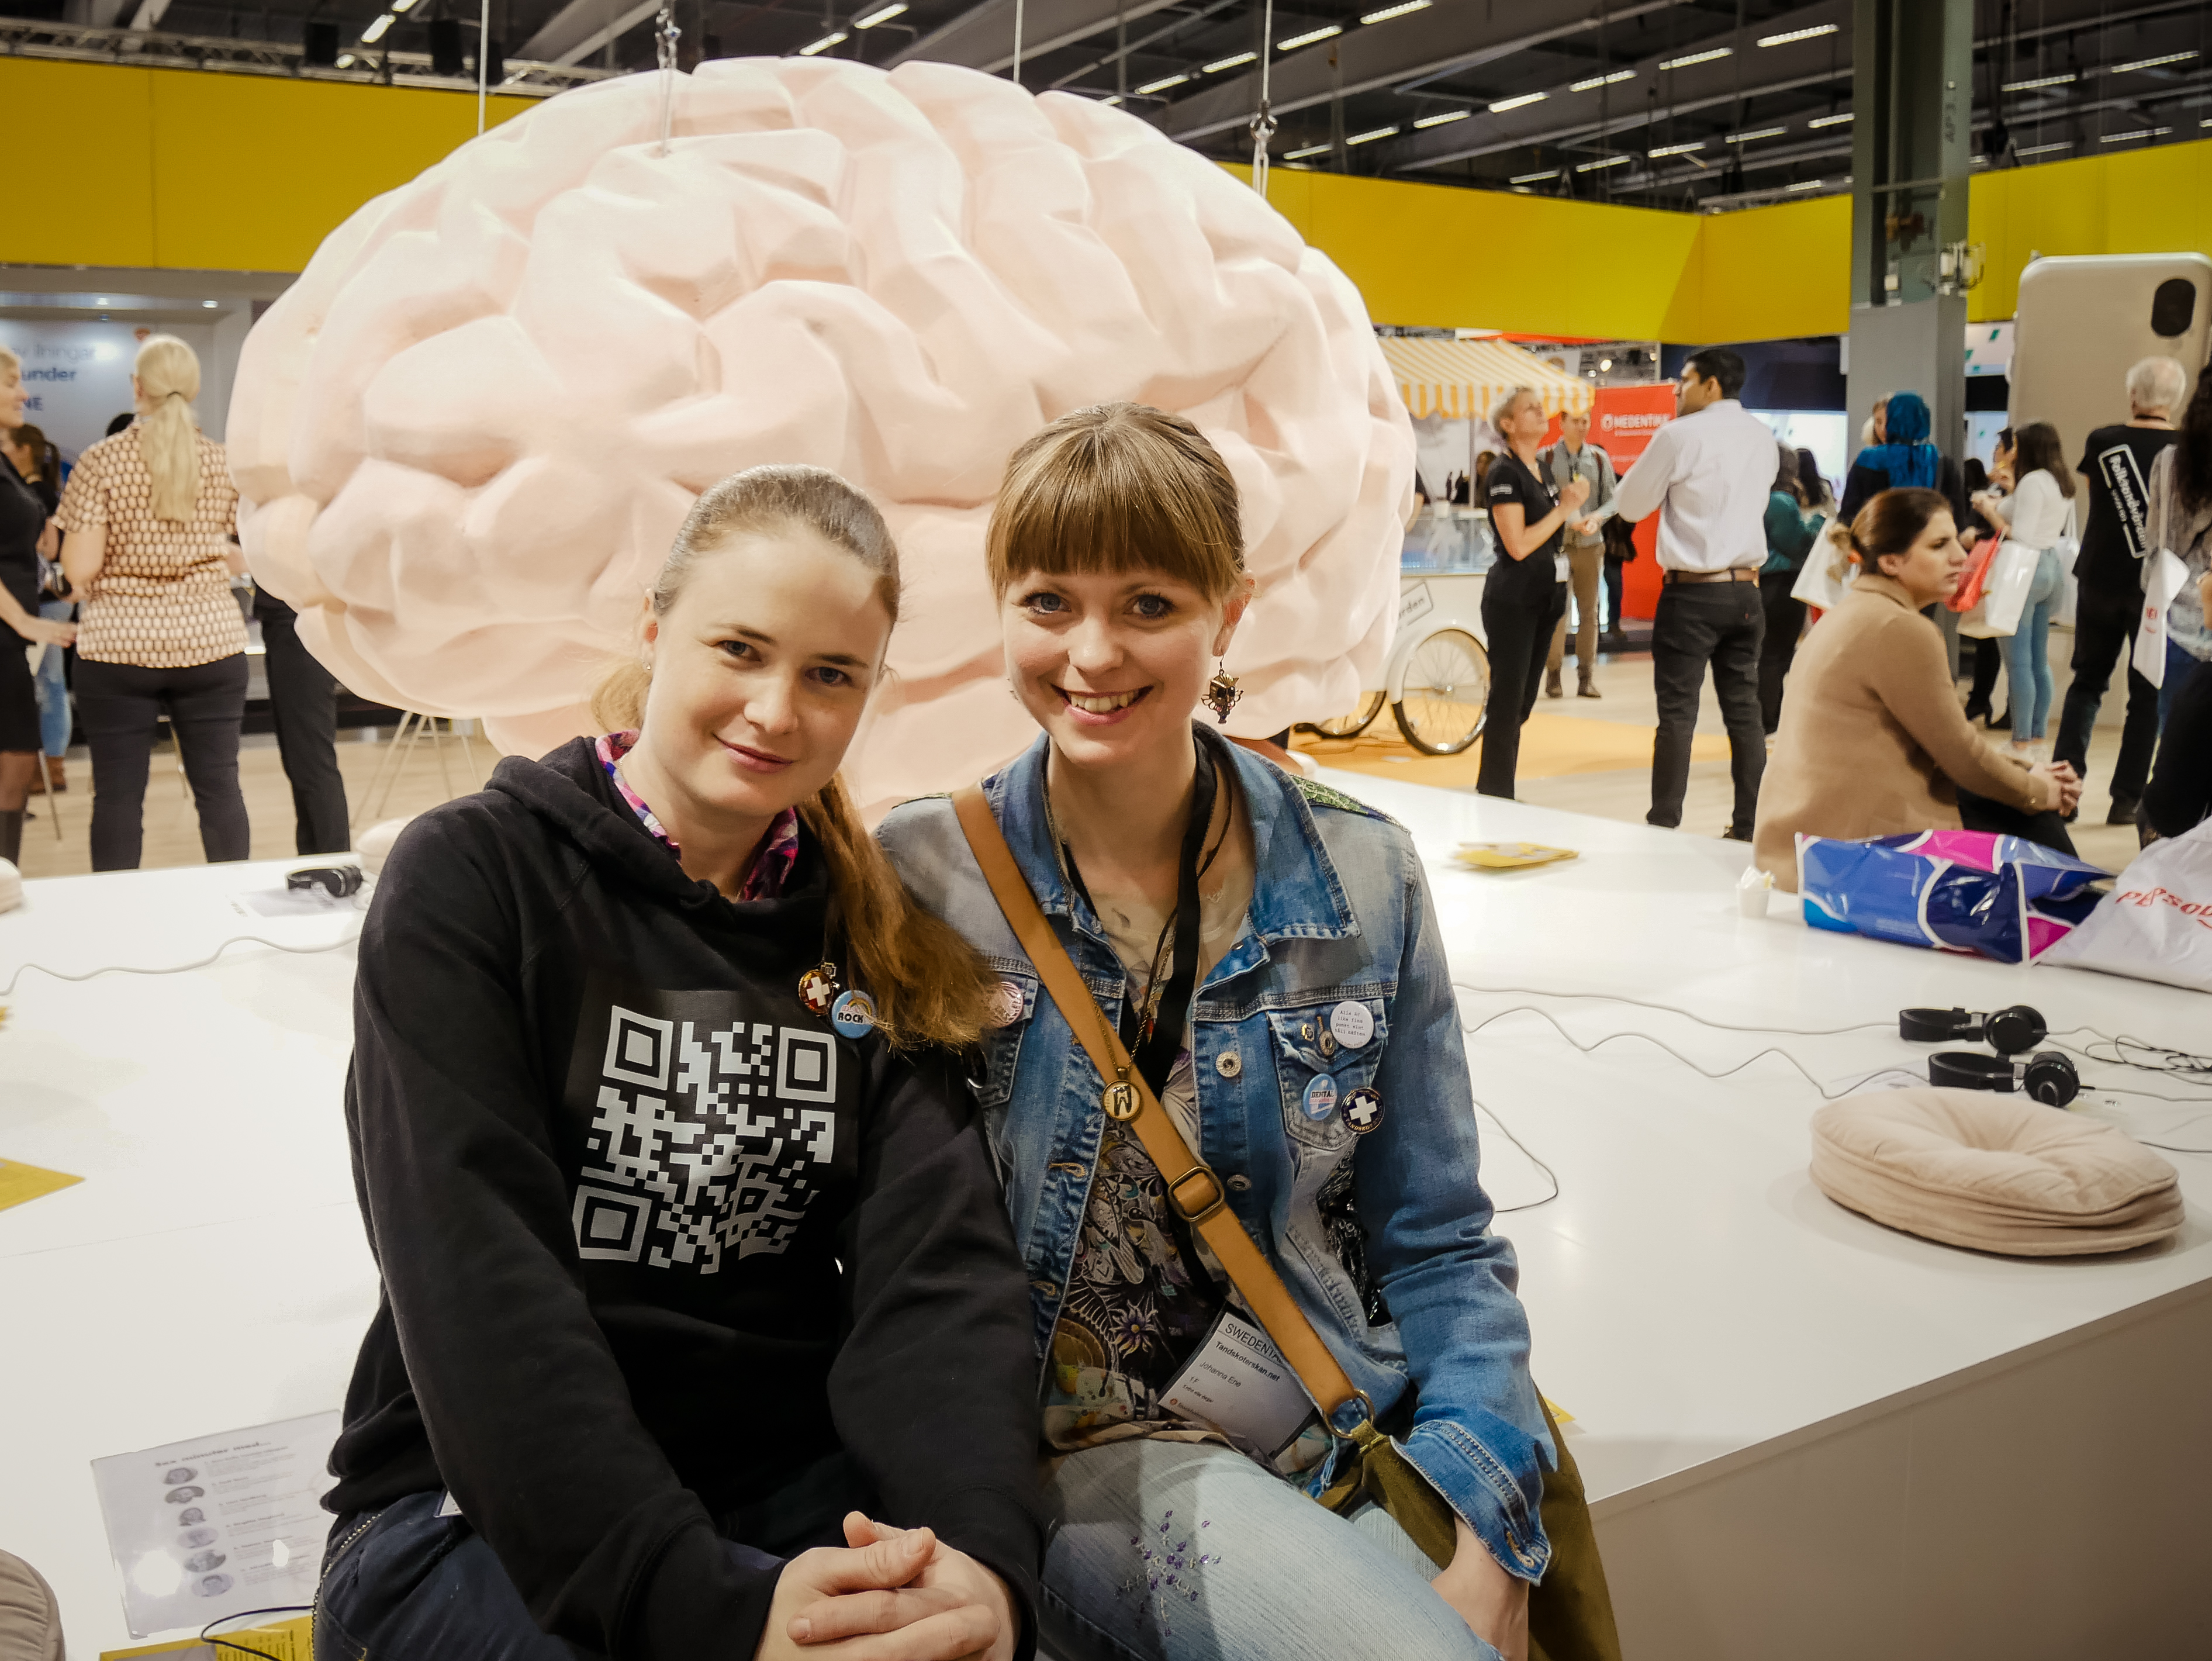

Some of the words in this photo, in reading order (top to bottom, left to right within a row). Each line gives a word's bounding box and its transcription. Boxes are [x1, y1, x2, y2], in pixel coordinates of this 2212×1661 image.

[838, 1012, 863, 1024] ROCK
[1199, 1361, 1228, 1380] Johanna
[1228, 1376, 1242, 1388] Ene
